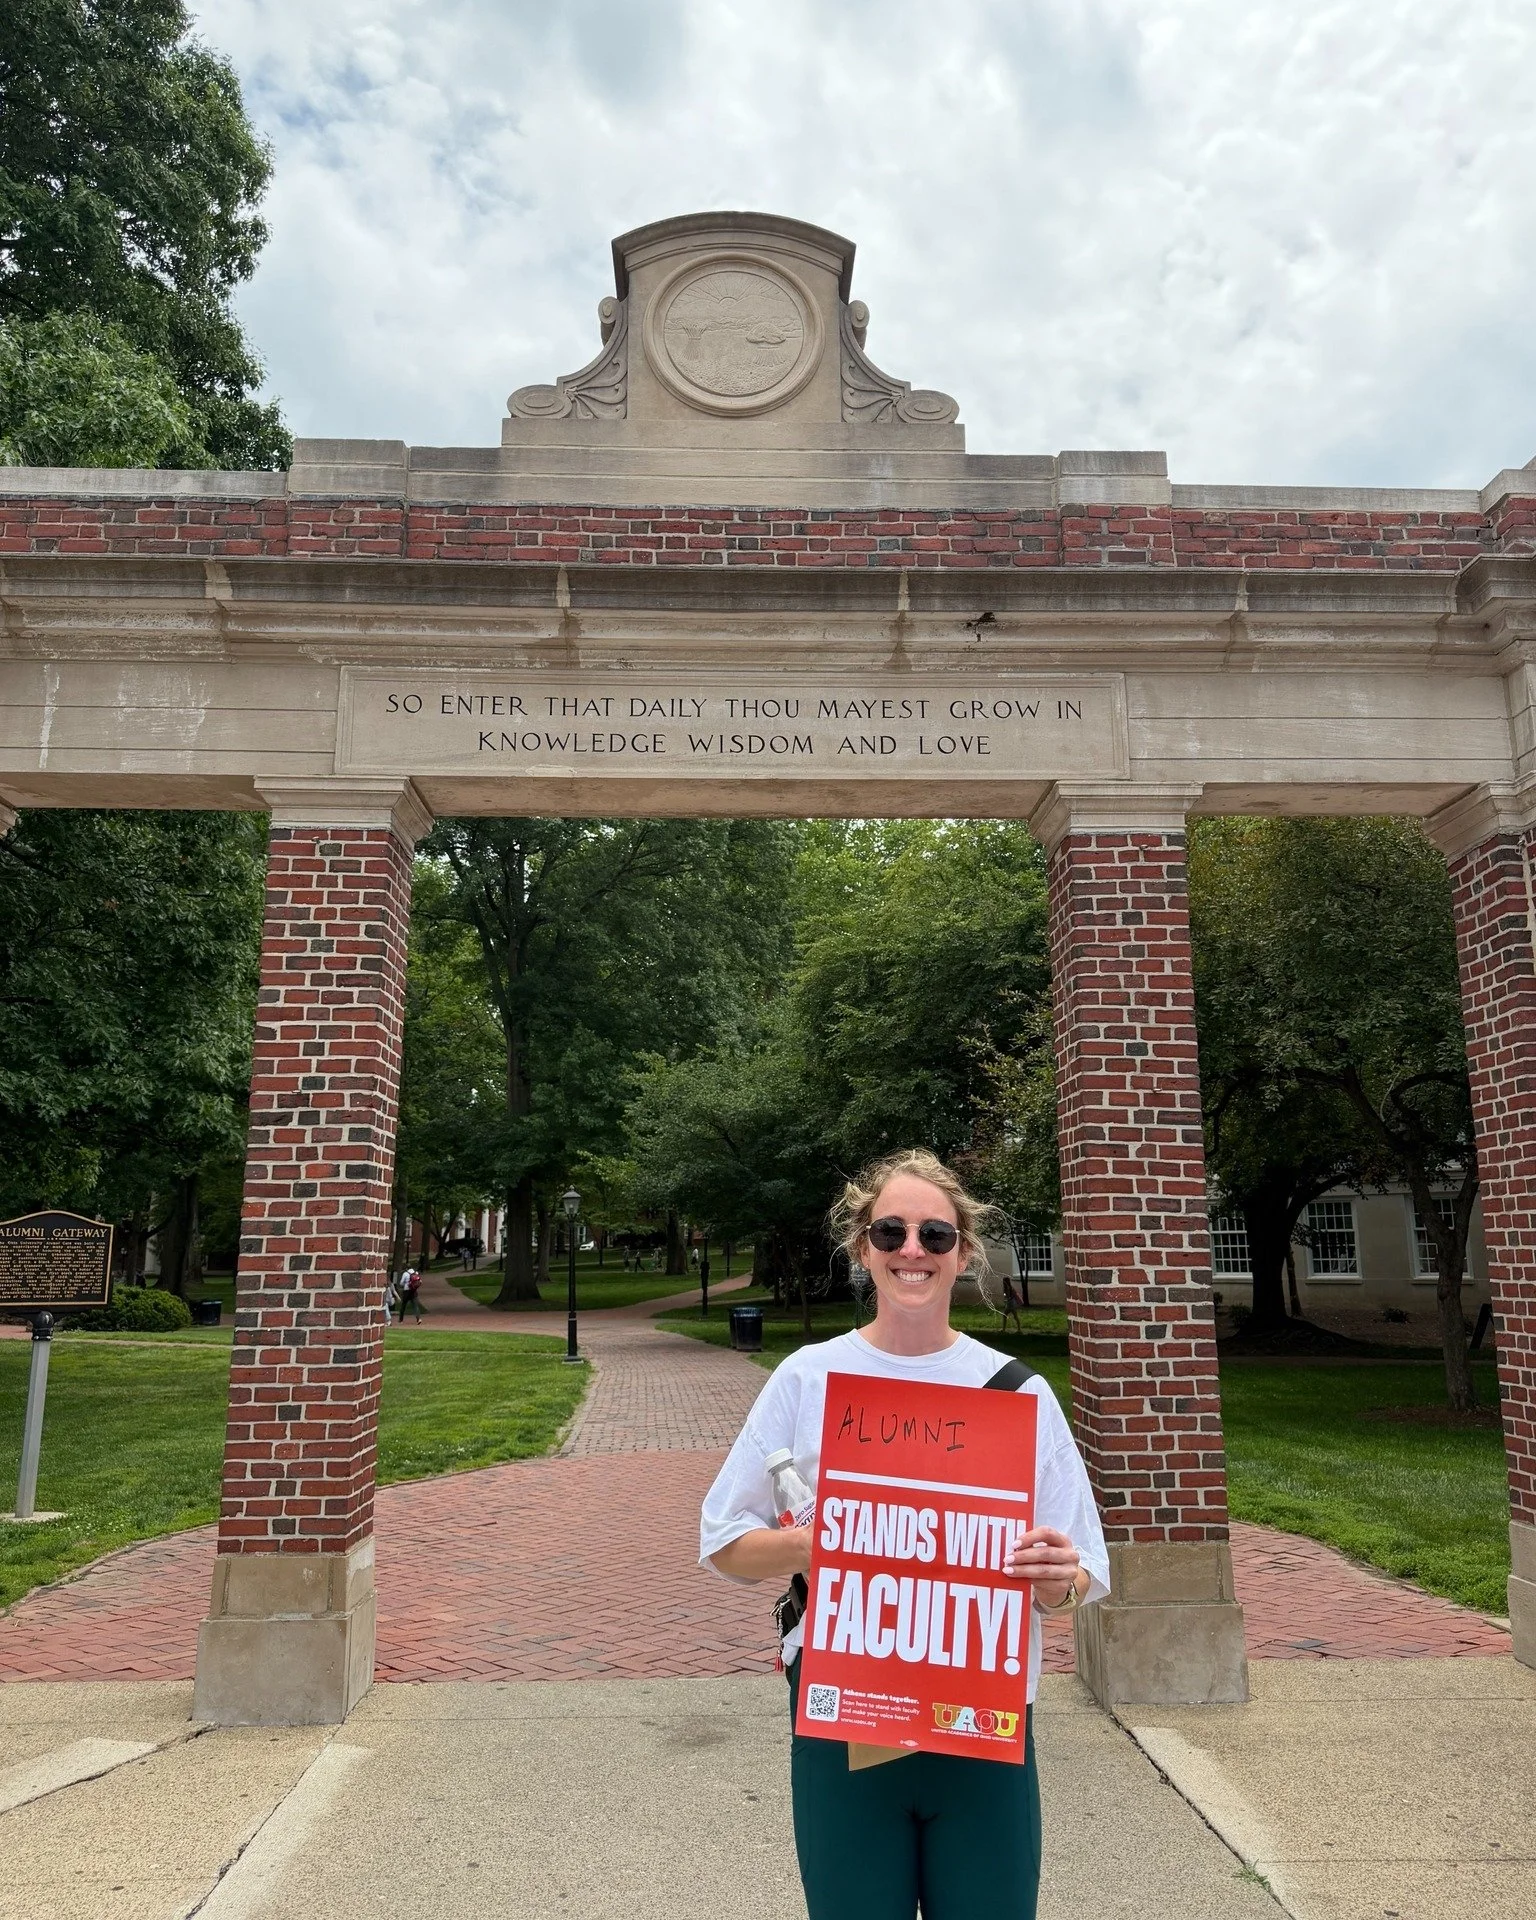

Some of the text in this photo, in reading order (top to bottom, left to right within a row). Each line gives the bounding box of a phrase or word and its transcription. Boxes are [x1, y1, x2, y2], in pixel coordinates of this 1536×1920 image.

[385, 694, 1083, 720] SO ENTER THAT DAILY THOU MAYEST GROW IN
[478, 731, 992, 755] KNOWLEDGE WISDOM AND LOVE
[0, 1228, 108, 1238] ALUMNI GATEWAY
[838, 1403, 965, 1451] ALUMNI
[820, 1496, 938, 1563] STANDS
[812, 1567, 1023, 1675] FACULTY!
[843, 1689, 920, 1704] Athens stands together.
[902, 1707, 920, 1715] faculty
[932, 1702, 1019, 1737] UAOU
